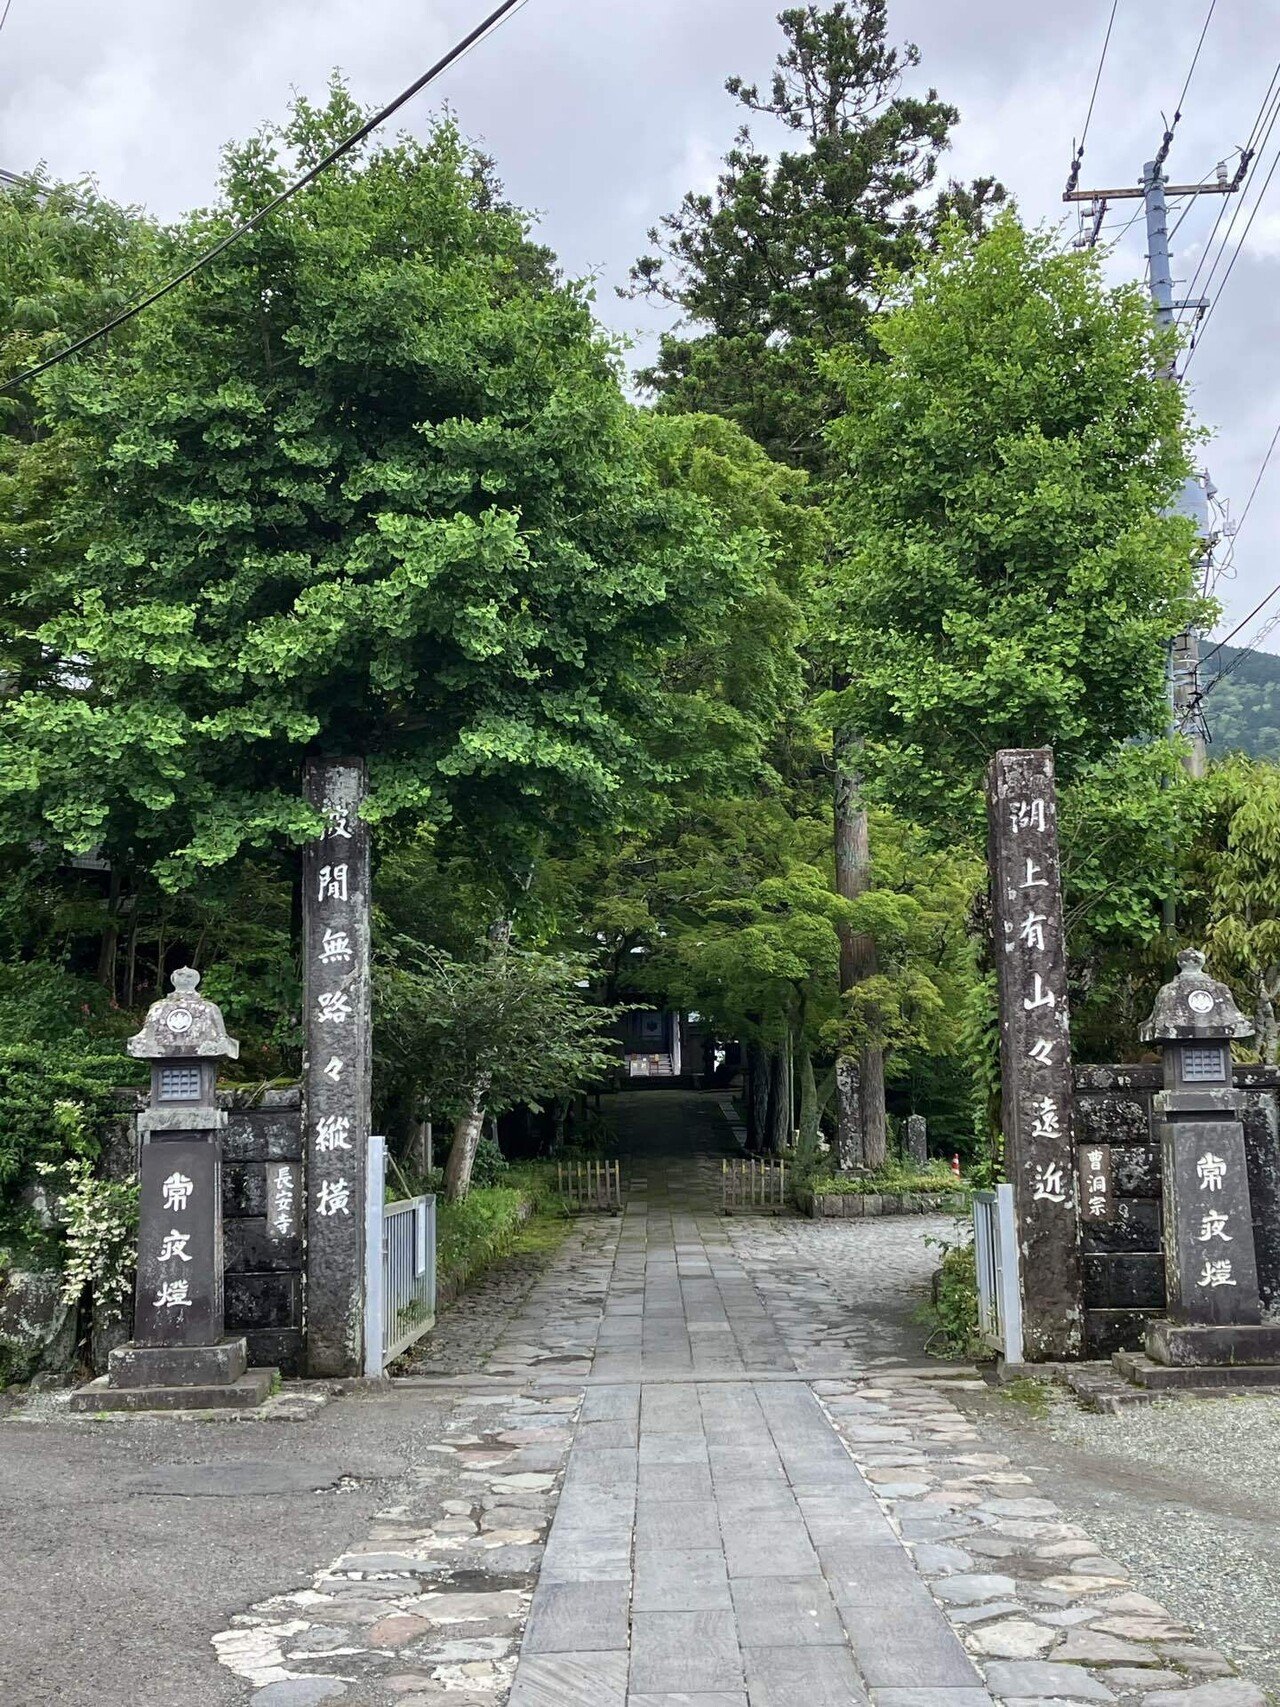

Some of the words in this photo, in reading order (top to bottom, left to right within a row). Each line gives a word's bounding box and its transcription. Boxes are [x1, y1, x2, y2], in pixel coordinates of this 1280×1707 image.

[273, 1166, 295, 1235] 長安寺
[1086, 1149, 1107, 1216] 曹洞宗
